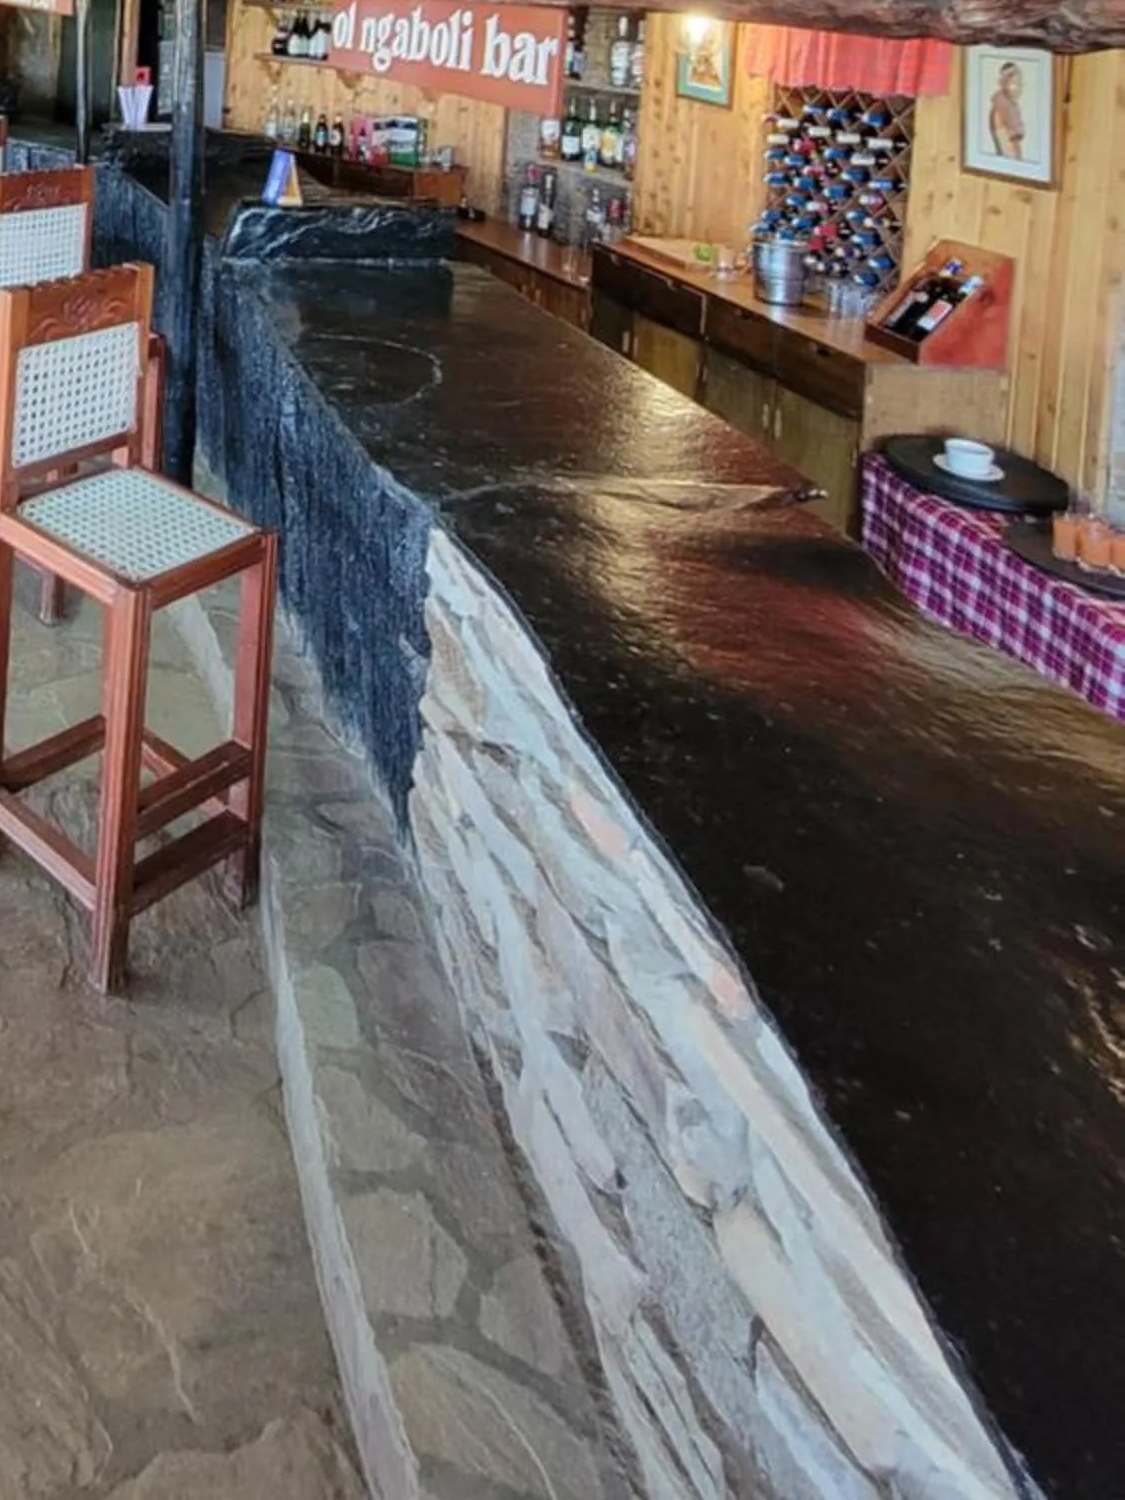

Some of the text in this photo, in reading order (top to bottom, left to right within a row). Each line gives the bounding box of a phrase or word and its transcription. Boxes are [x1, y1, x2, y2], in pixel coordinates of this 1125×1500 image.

[333, 1, 559, 85] ol ngaboli bar
